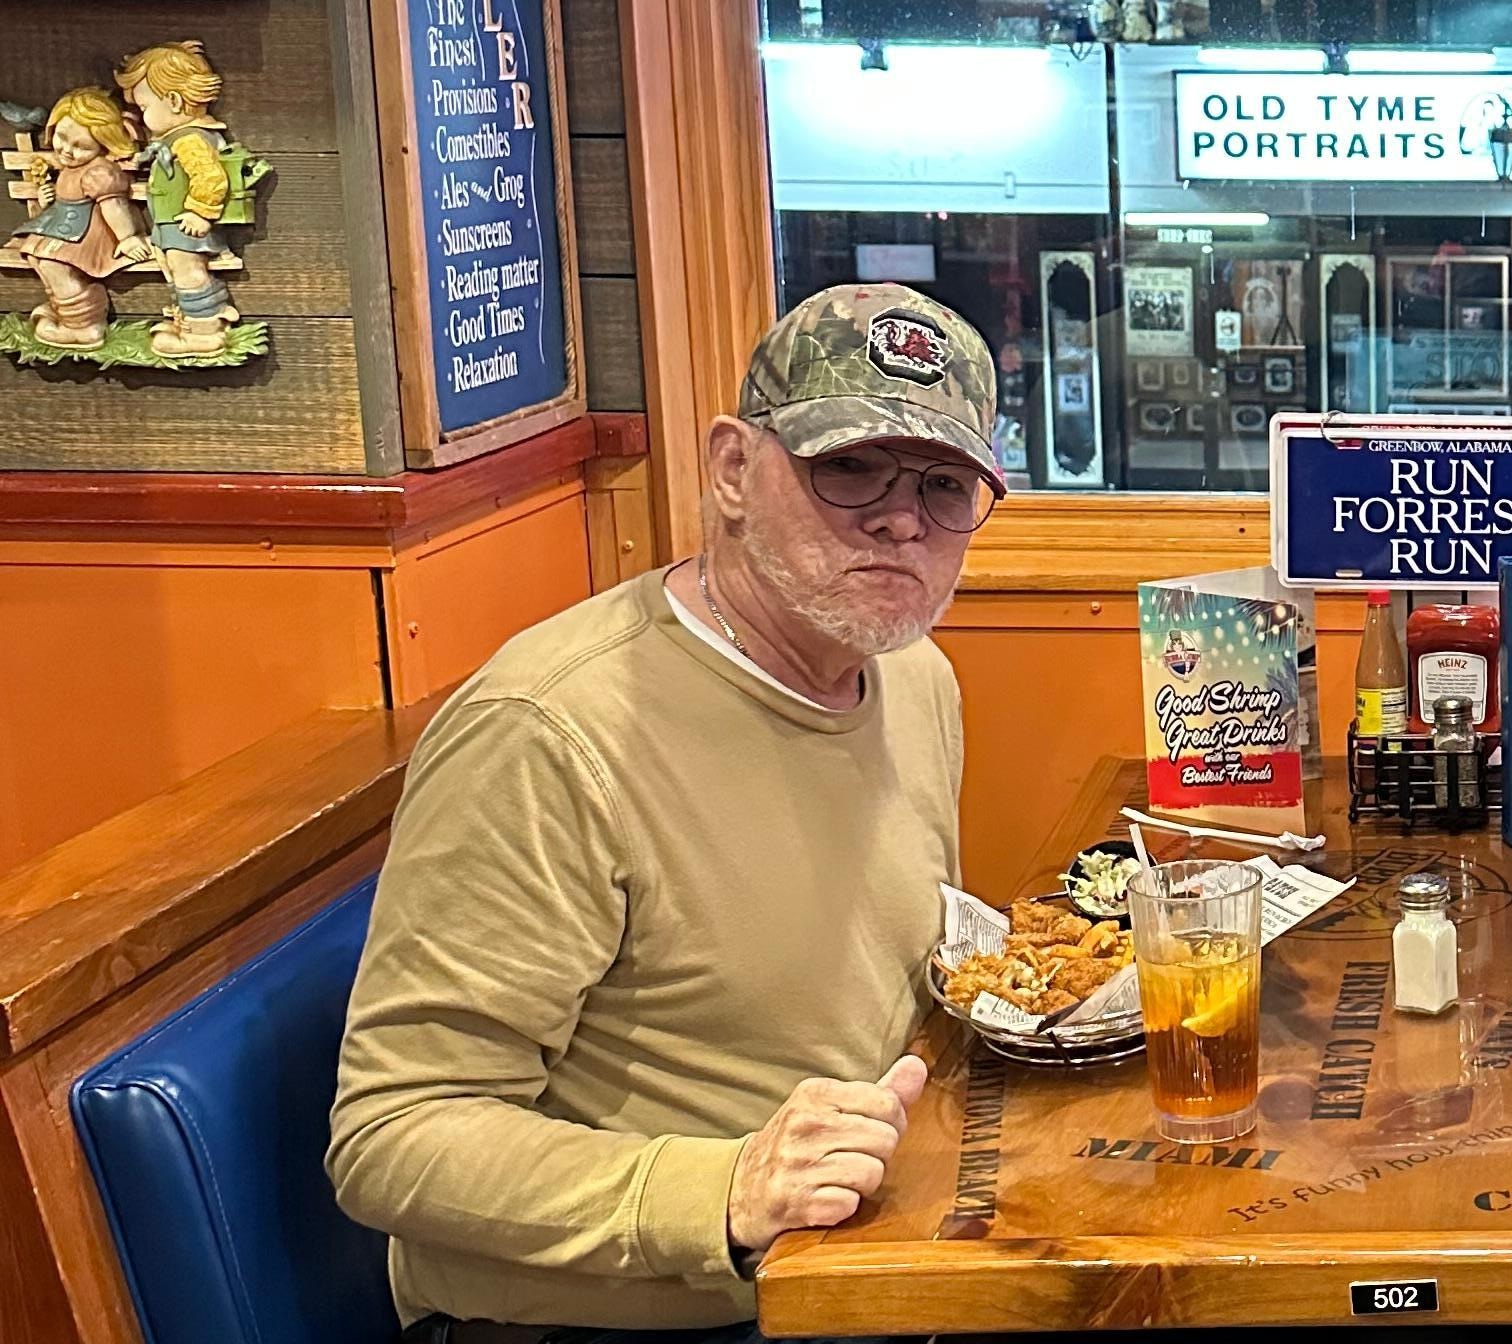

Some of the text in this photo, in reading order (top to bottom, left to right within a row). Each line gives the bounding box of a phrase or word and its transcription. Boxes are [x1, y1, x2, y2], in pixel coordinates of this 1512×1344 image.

[428, 26, 478, 77] Finest
[432, 78, 498, 118] Provisions
[1202, 94, 1436, 122] OLD TYME
[436, 125, 511, 166] Comestibles
[1193, 131, 1445, 159] PORTRAITS
[441, 165, 525, 212] Ales and Grog
[442, 216, 512, 258] Sunscreens
[446, 255, 540, 303] Reading matter
[449, 301, 525, 347] Good Times
[453, 346, 518, 393] Relaxation
[1368, 439, 1512, 454] GREENBOW, ALABAMA
[1390, 458, 1495, 496] RUN
[1389, 538, 1493, 576] RUN
[1437, 658, 1468, 670] HEINZ
[1156, 681, 1281, 730] Good Shrimp
[1166, 716, 1287, 764] Great Drinks
[1226, 762, 1273, 783] Friends
[1310, 960, 1391, 1121] FRESH CATCH
[953, 1055, 1006, 1223] DAYTONA BEACH
[1073, 1137, 1285, 1172] MIAMI
[1227, 1196, 1288, 1223] It's
[1292, 1163, 1382, 1203] funny
[1388, 1142, 1455, 1172] how
[1373, 1286, 1420, 1310] 502
